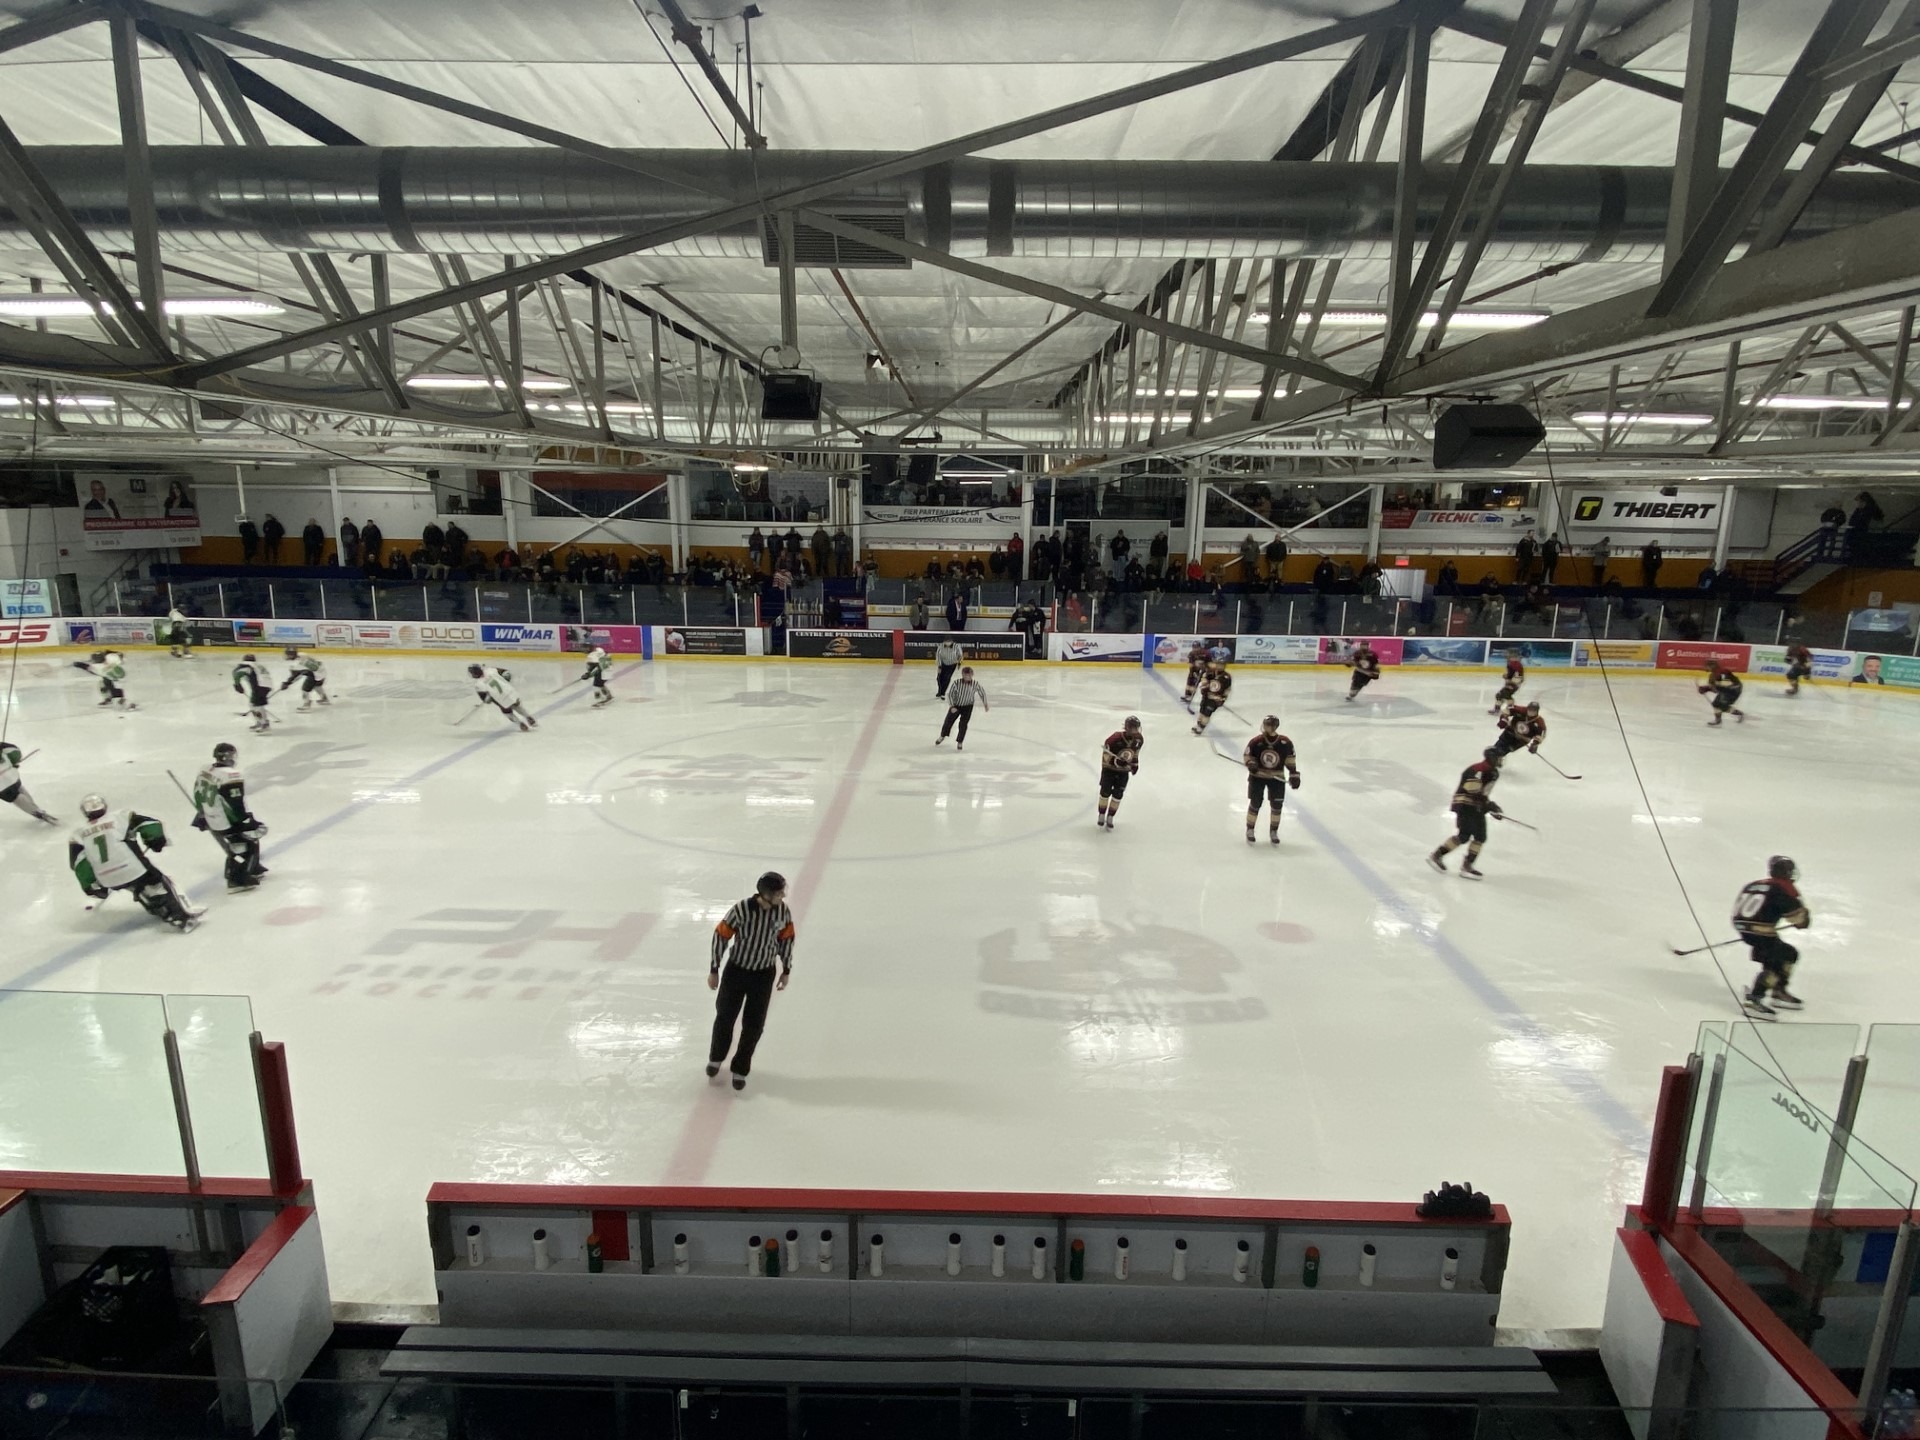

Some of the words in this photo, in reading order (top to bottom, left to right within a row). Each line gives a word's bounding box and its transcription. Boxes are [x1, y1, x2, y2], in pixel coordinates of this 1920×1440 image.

[1613, 502, 1717, 519] THIBERT
[1429, 512, 1480, 523] TECNIC
[421, 627, 475, 640] DUCO
[494, 628, 553, 640] WINMAR
[835, 631, 887, 639] PERFORMANCE
[93, 834, 109, 864] 1
